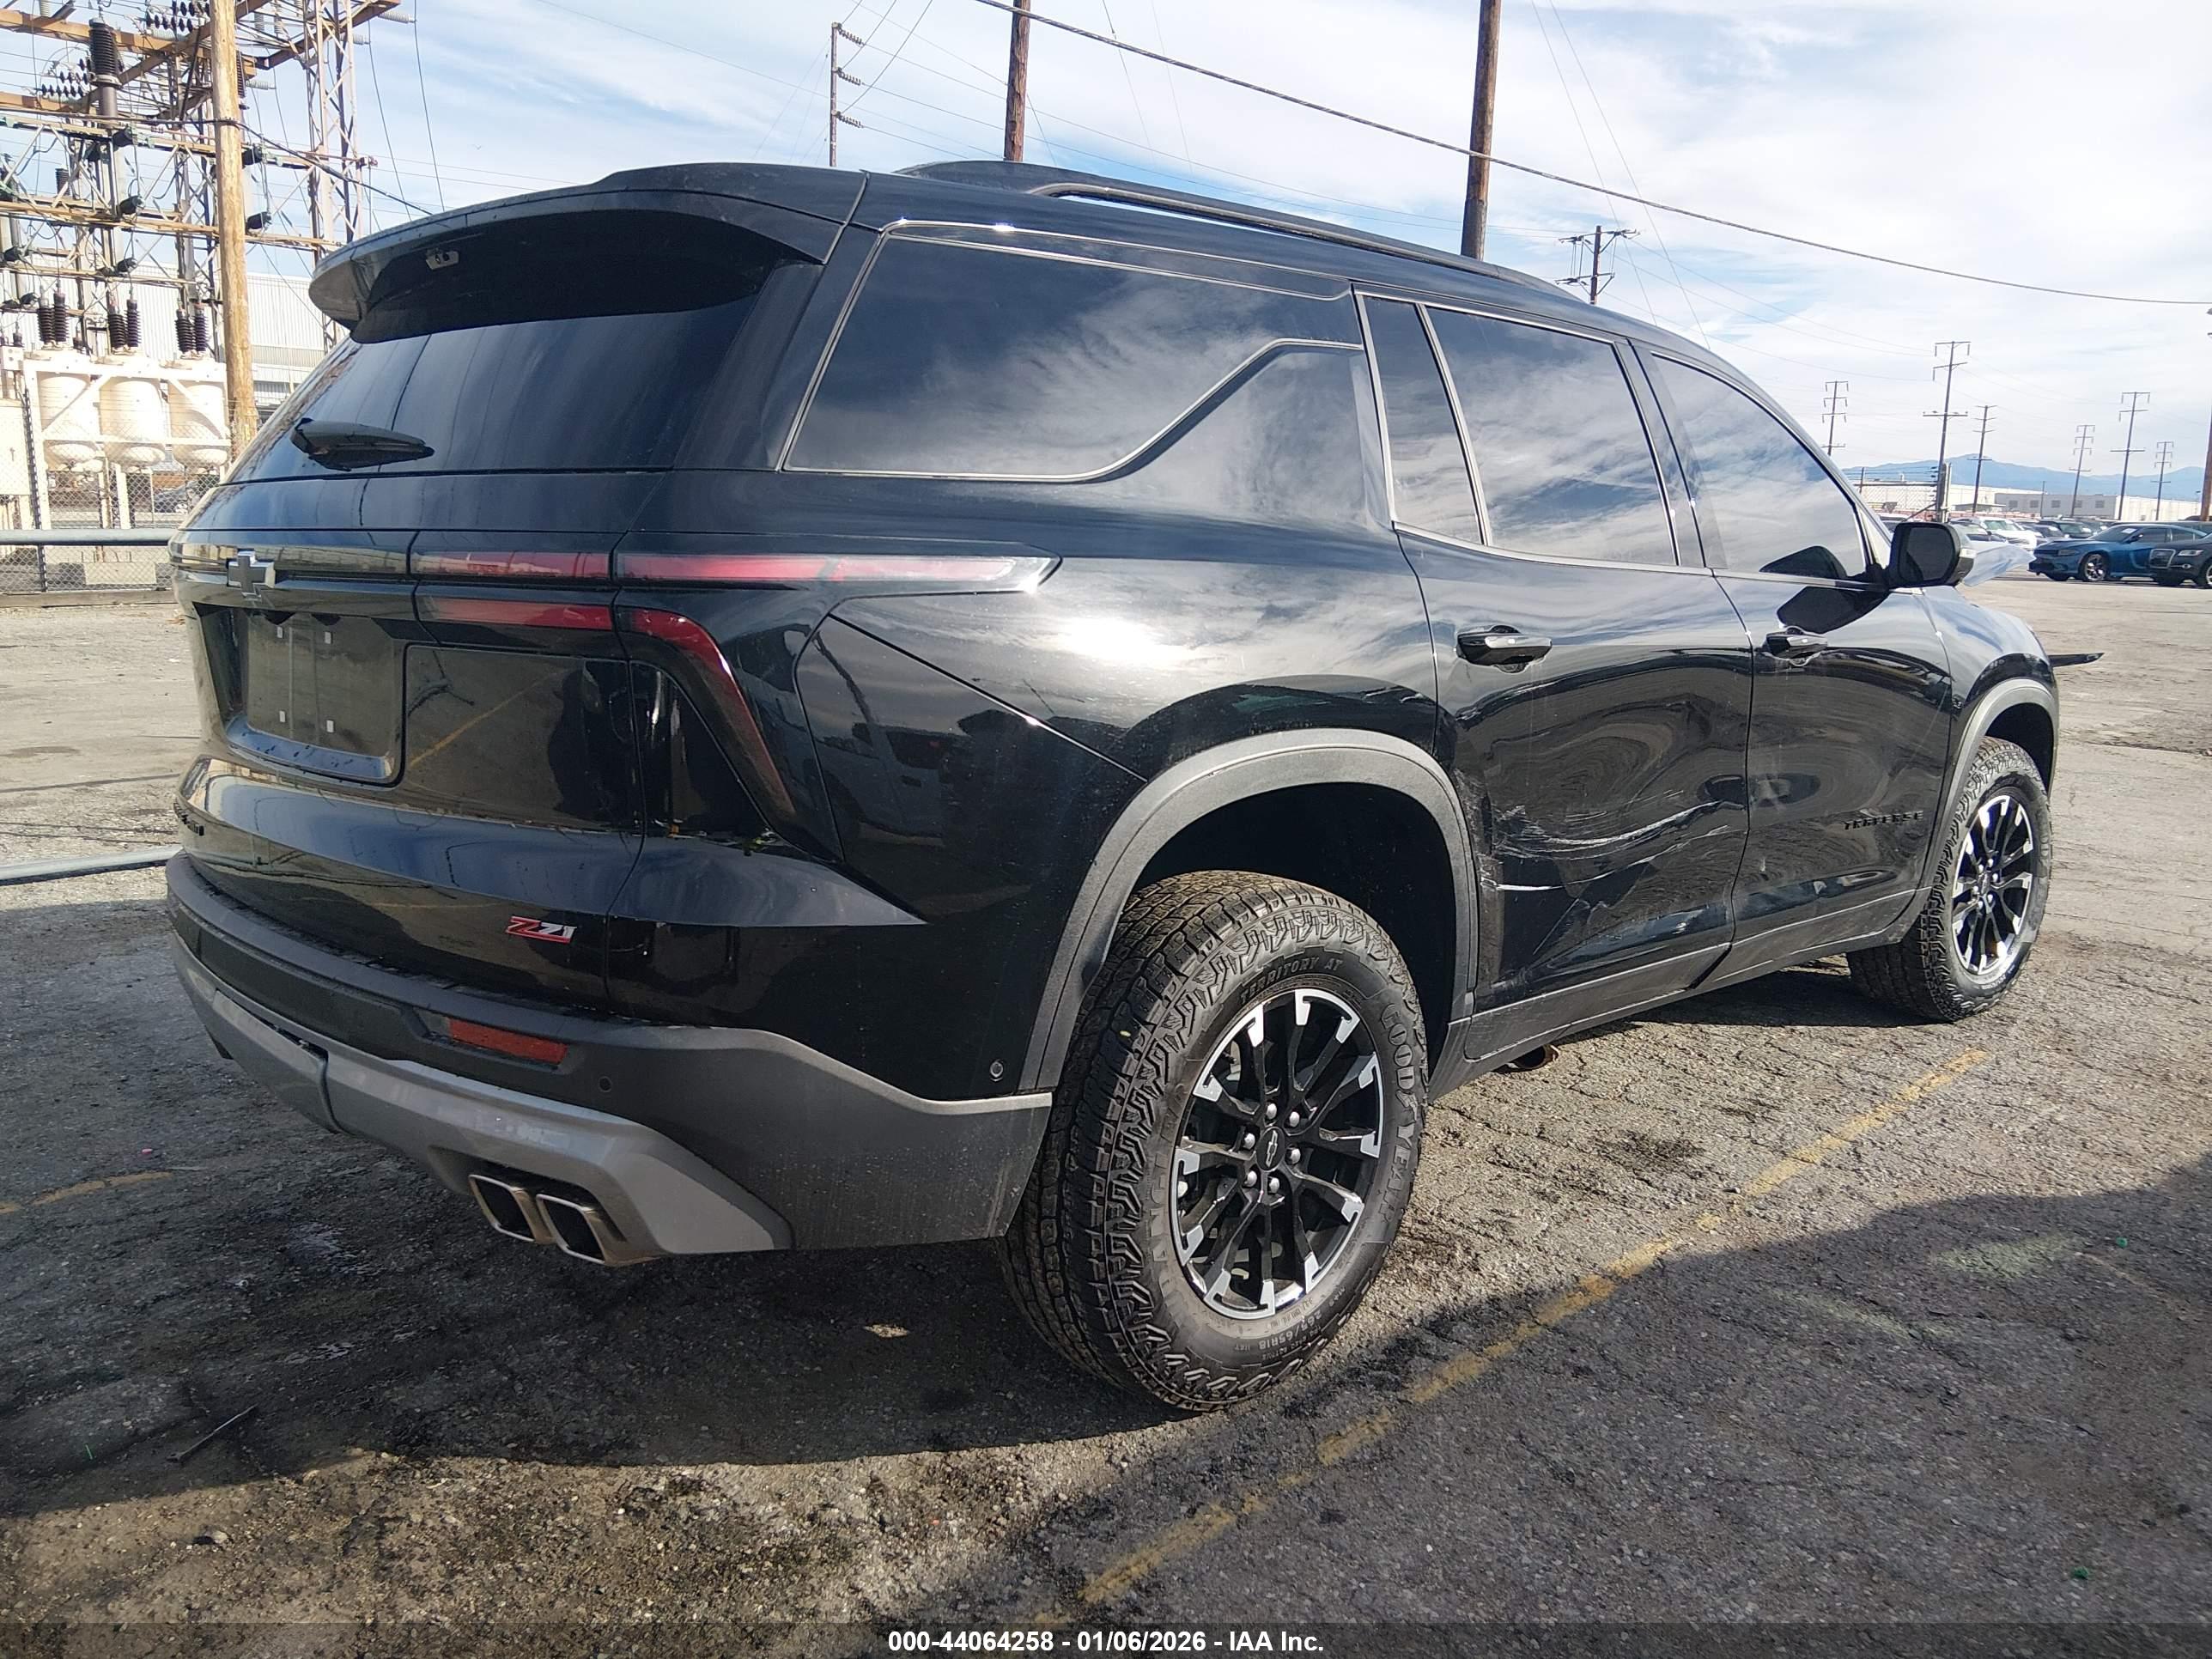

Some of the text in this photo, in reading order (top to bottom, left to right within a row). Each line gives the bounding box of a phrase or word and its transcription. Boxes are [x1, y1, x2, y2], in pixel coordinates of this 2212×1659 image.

[505, 915, 577, 944] Z71
[1239, 957, 1344, 1005] TERRITORY AT
[1379, 1003, 1419, 1223] GOODYEAR
[1258, 1308, 1322, 1349] 265/65R18
